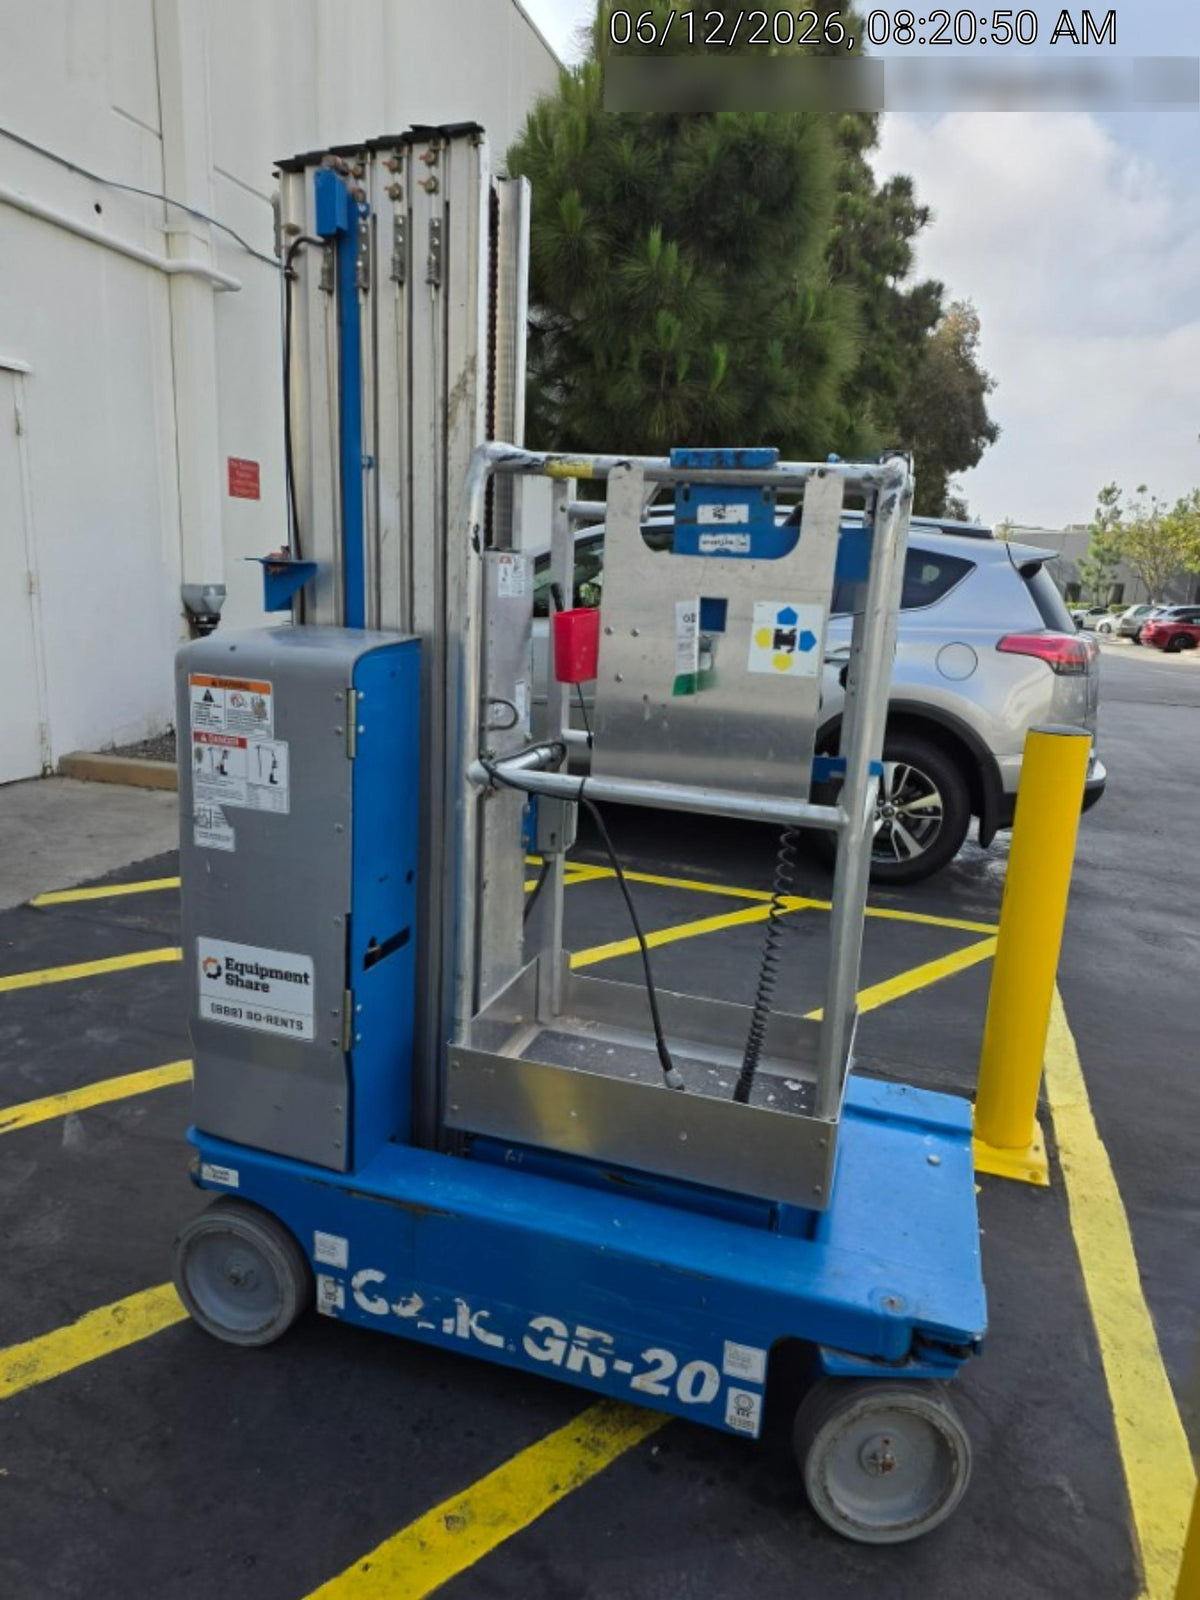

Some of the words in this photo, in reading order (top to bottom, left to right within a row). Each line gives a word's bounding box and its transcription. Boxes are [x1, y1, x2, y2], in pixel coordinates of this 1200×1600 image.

[225, 957, 310, 985] Equipment
[225, 973, 270, 993] Share
[522, 1316, 721, 1404] GR-20
